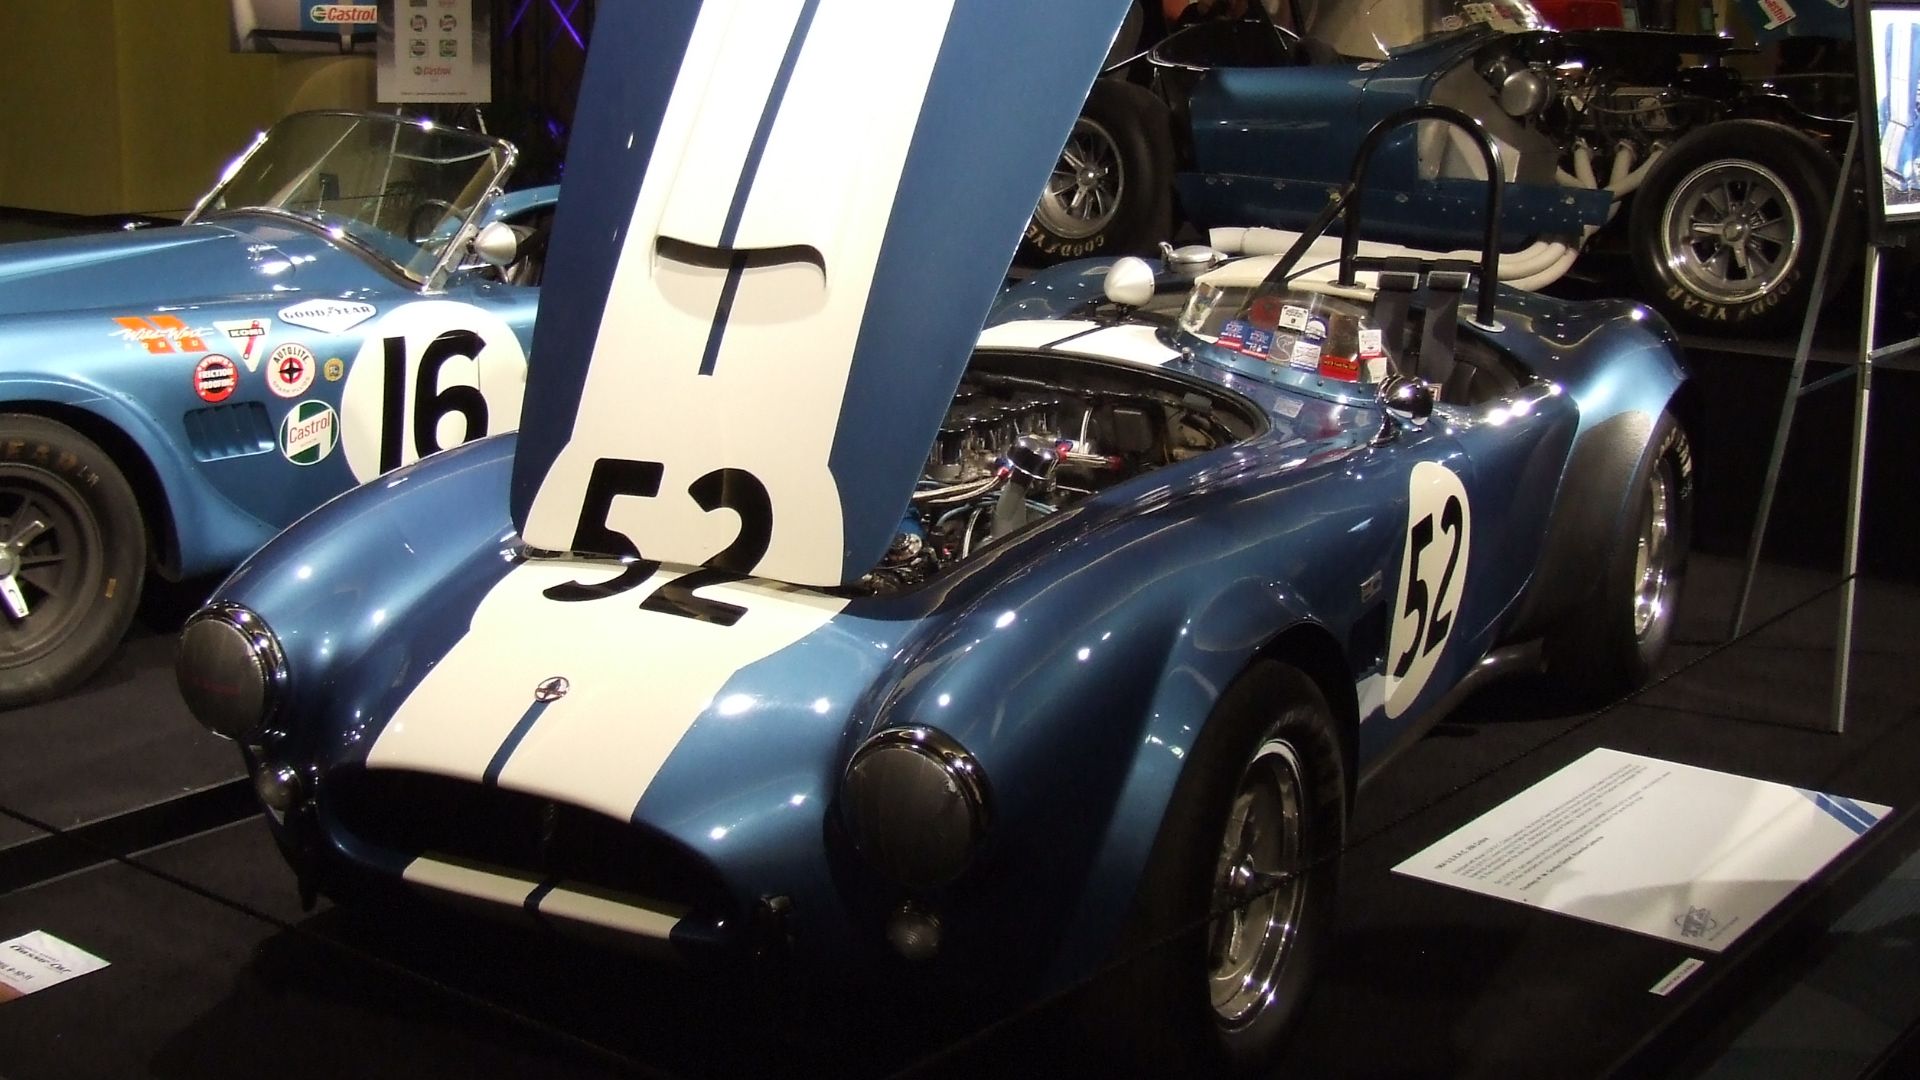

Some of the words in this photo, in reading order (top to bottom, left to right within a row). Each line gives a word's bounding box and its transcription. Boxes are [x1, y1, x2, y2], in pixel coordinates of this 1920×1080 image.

[327, 7, 375, 21] Castrol
[1765, 0, 1791, 23] astrol
[273, 346, 309, 363] AUTOLITE
[199, 367, 234, 379] FRICTION
[199, 378, 234, 390] PROOFING
[379, 329, 488, 476] 16
[289, 411, 331, 443] Castrol
[543, 457, 773, 627] 52
[1393, 495, 1463, 678] 52
